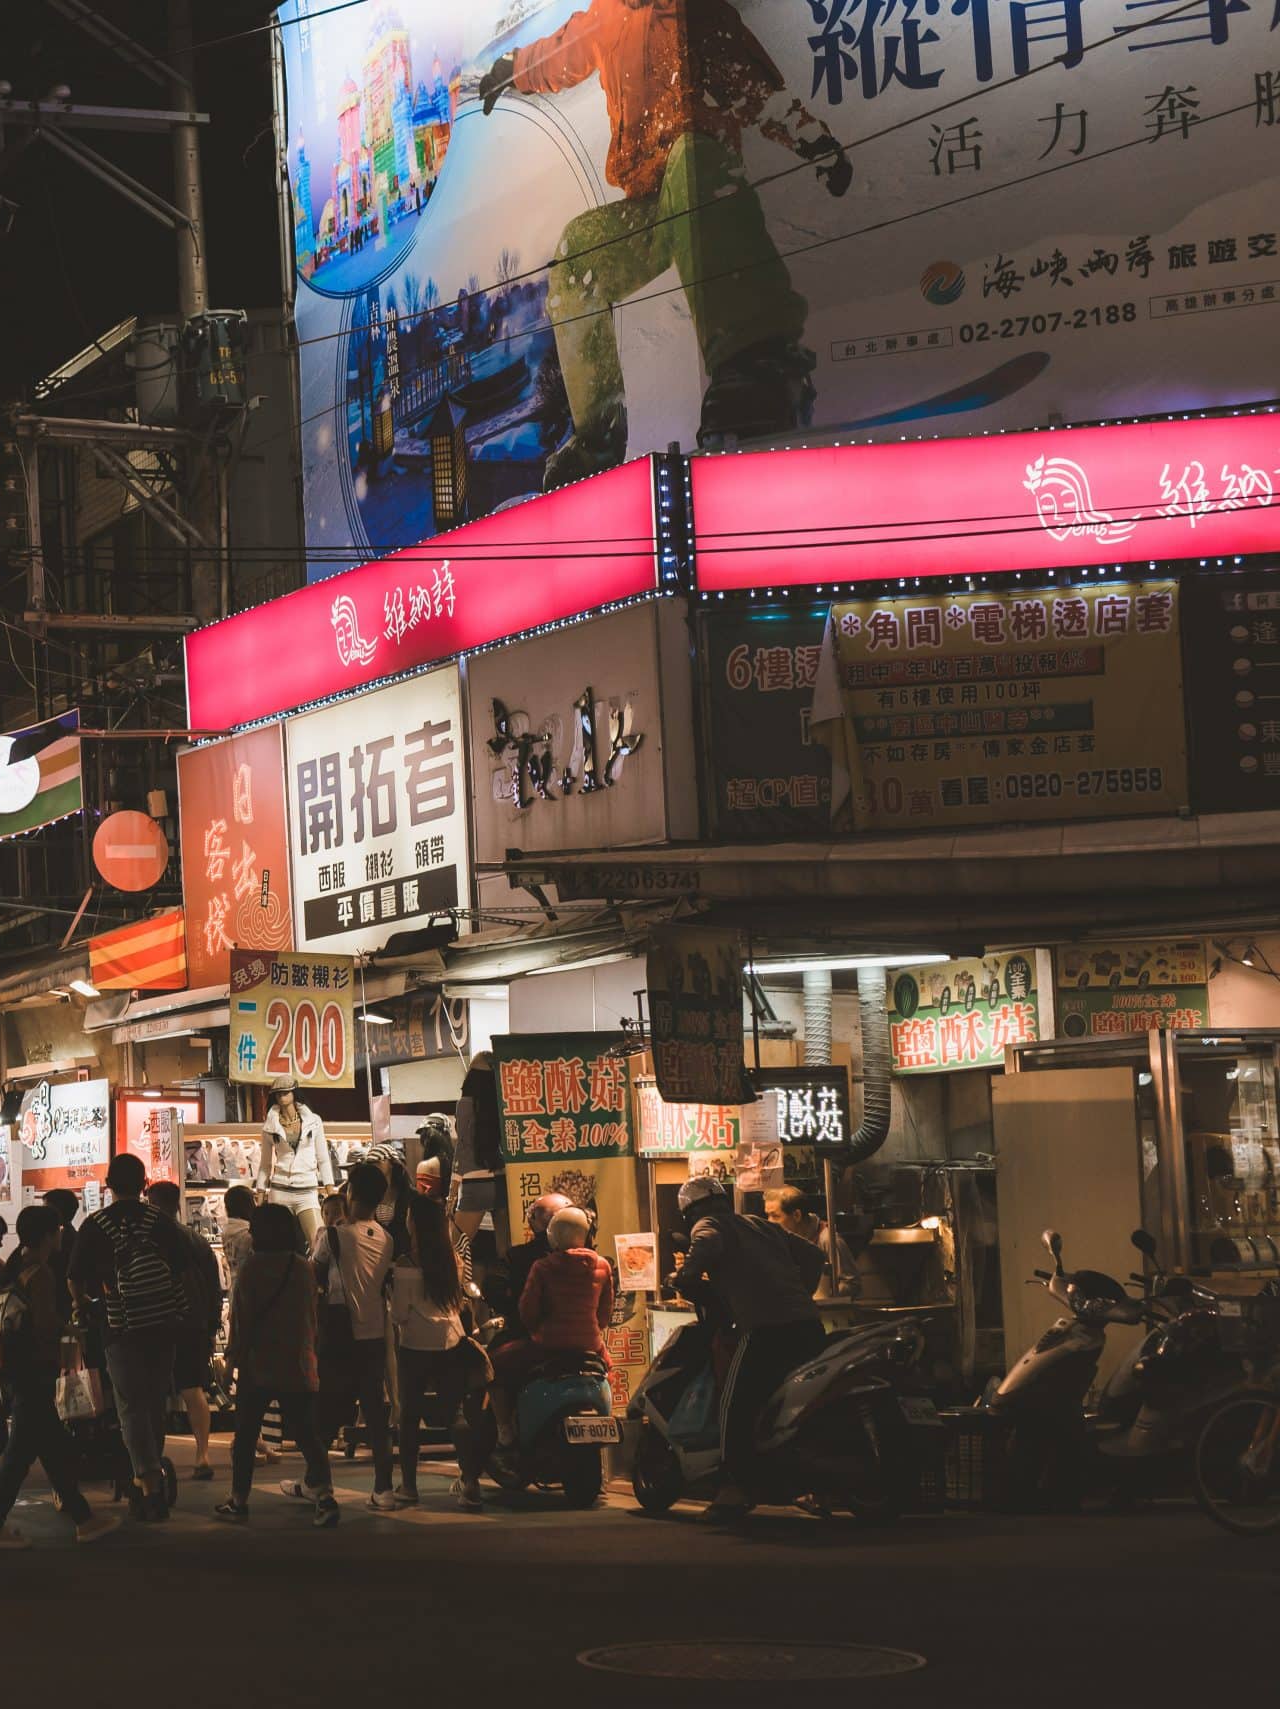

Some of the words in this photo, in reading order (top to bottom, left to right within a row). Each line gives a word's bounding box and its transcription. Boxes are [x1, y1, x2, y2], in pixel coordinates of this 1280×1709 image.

[958, 302, 1137, 344] 02-2707-2188
[1155, 460, 1280, 529] 維納
[297, 720, 455, 856] 開拓者
[318, 861, 346, 892] 西服
[365, 848, 394, 881] 襯衫
[414, 835, 445, 869] 領帶
[337, 879, 420, 928] 平價量販
[271, 961, 350, 989] 防皺襯衫
[237, 1000, 257, 1072] 一件
[265, 998, 346, 1081] 200
[500, 1055, 626, 1117] 鹽酥菇
